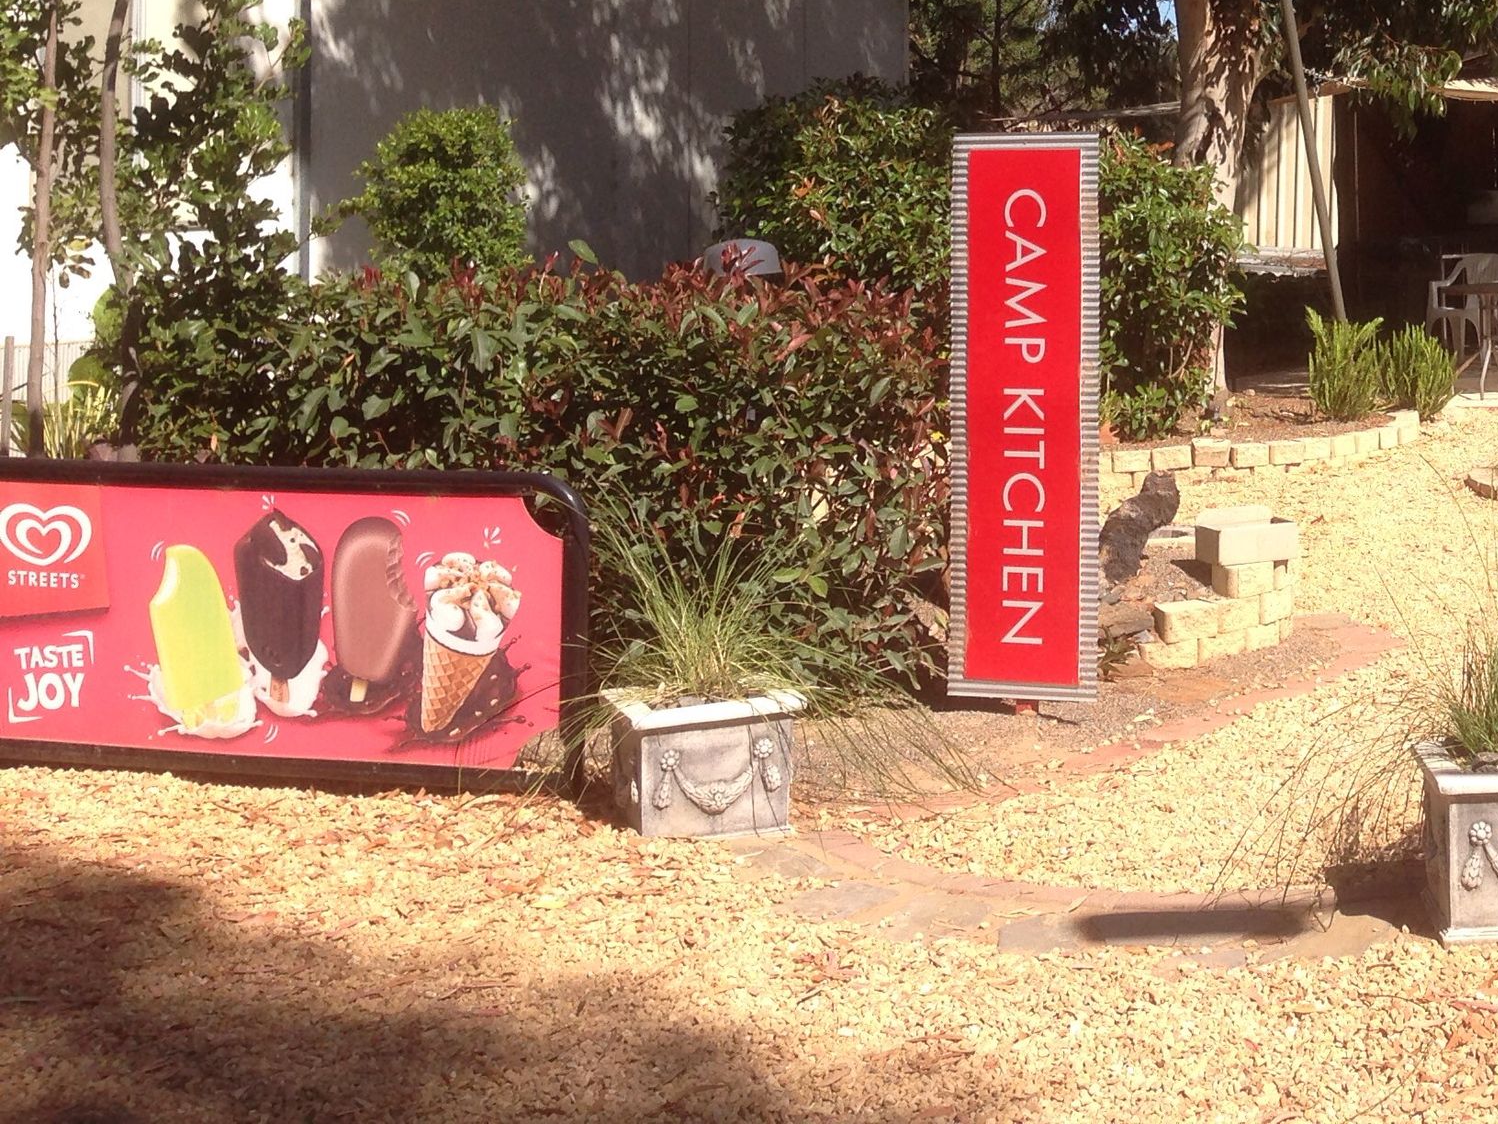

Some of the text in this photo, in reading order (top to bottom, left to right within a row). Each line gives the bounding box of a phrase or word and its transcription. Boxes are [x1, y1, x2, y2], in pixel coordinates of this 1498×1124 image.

[1001, 188, 1047, 646] CAMP KITCHEN
[8, 569, 80, 589] STREETS
[13, 643, 85, 670] TASTE
[16, 671, 85, 712] JOY
